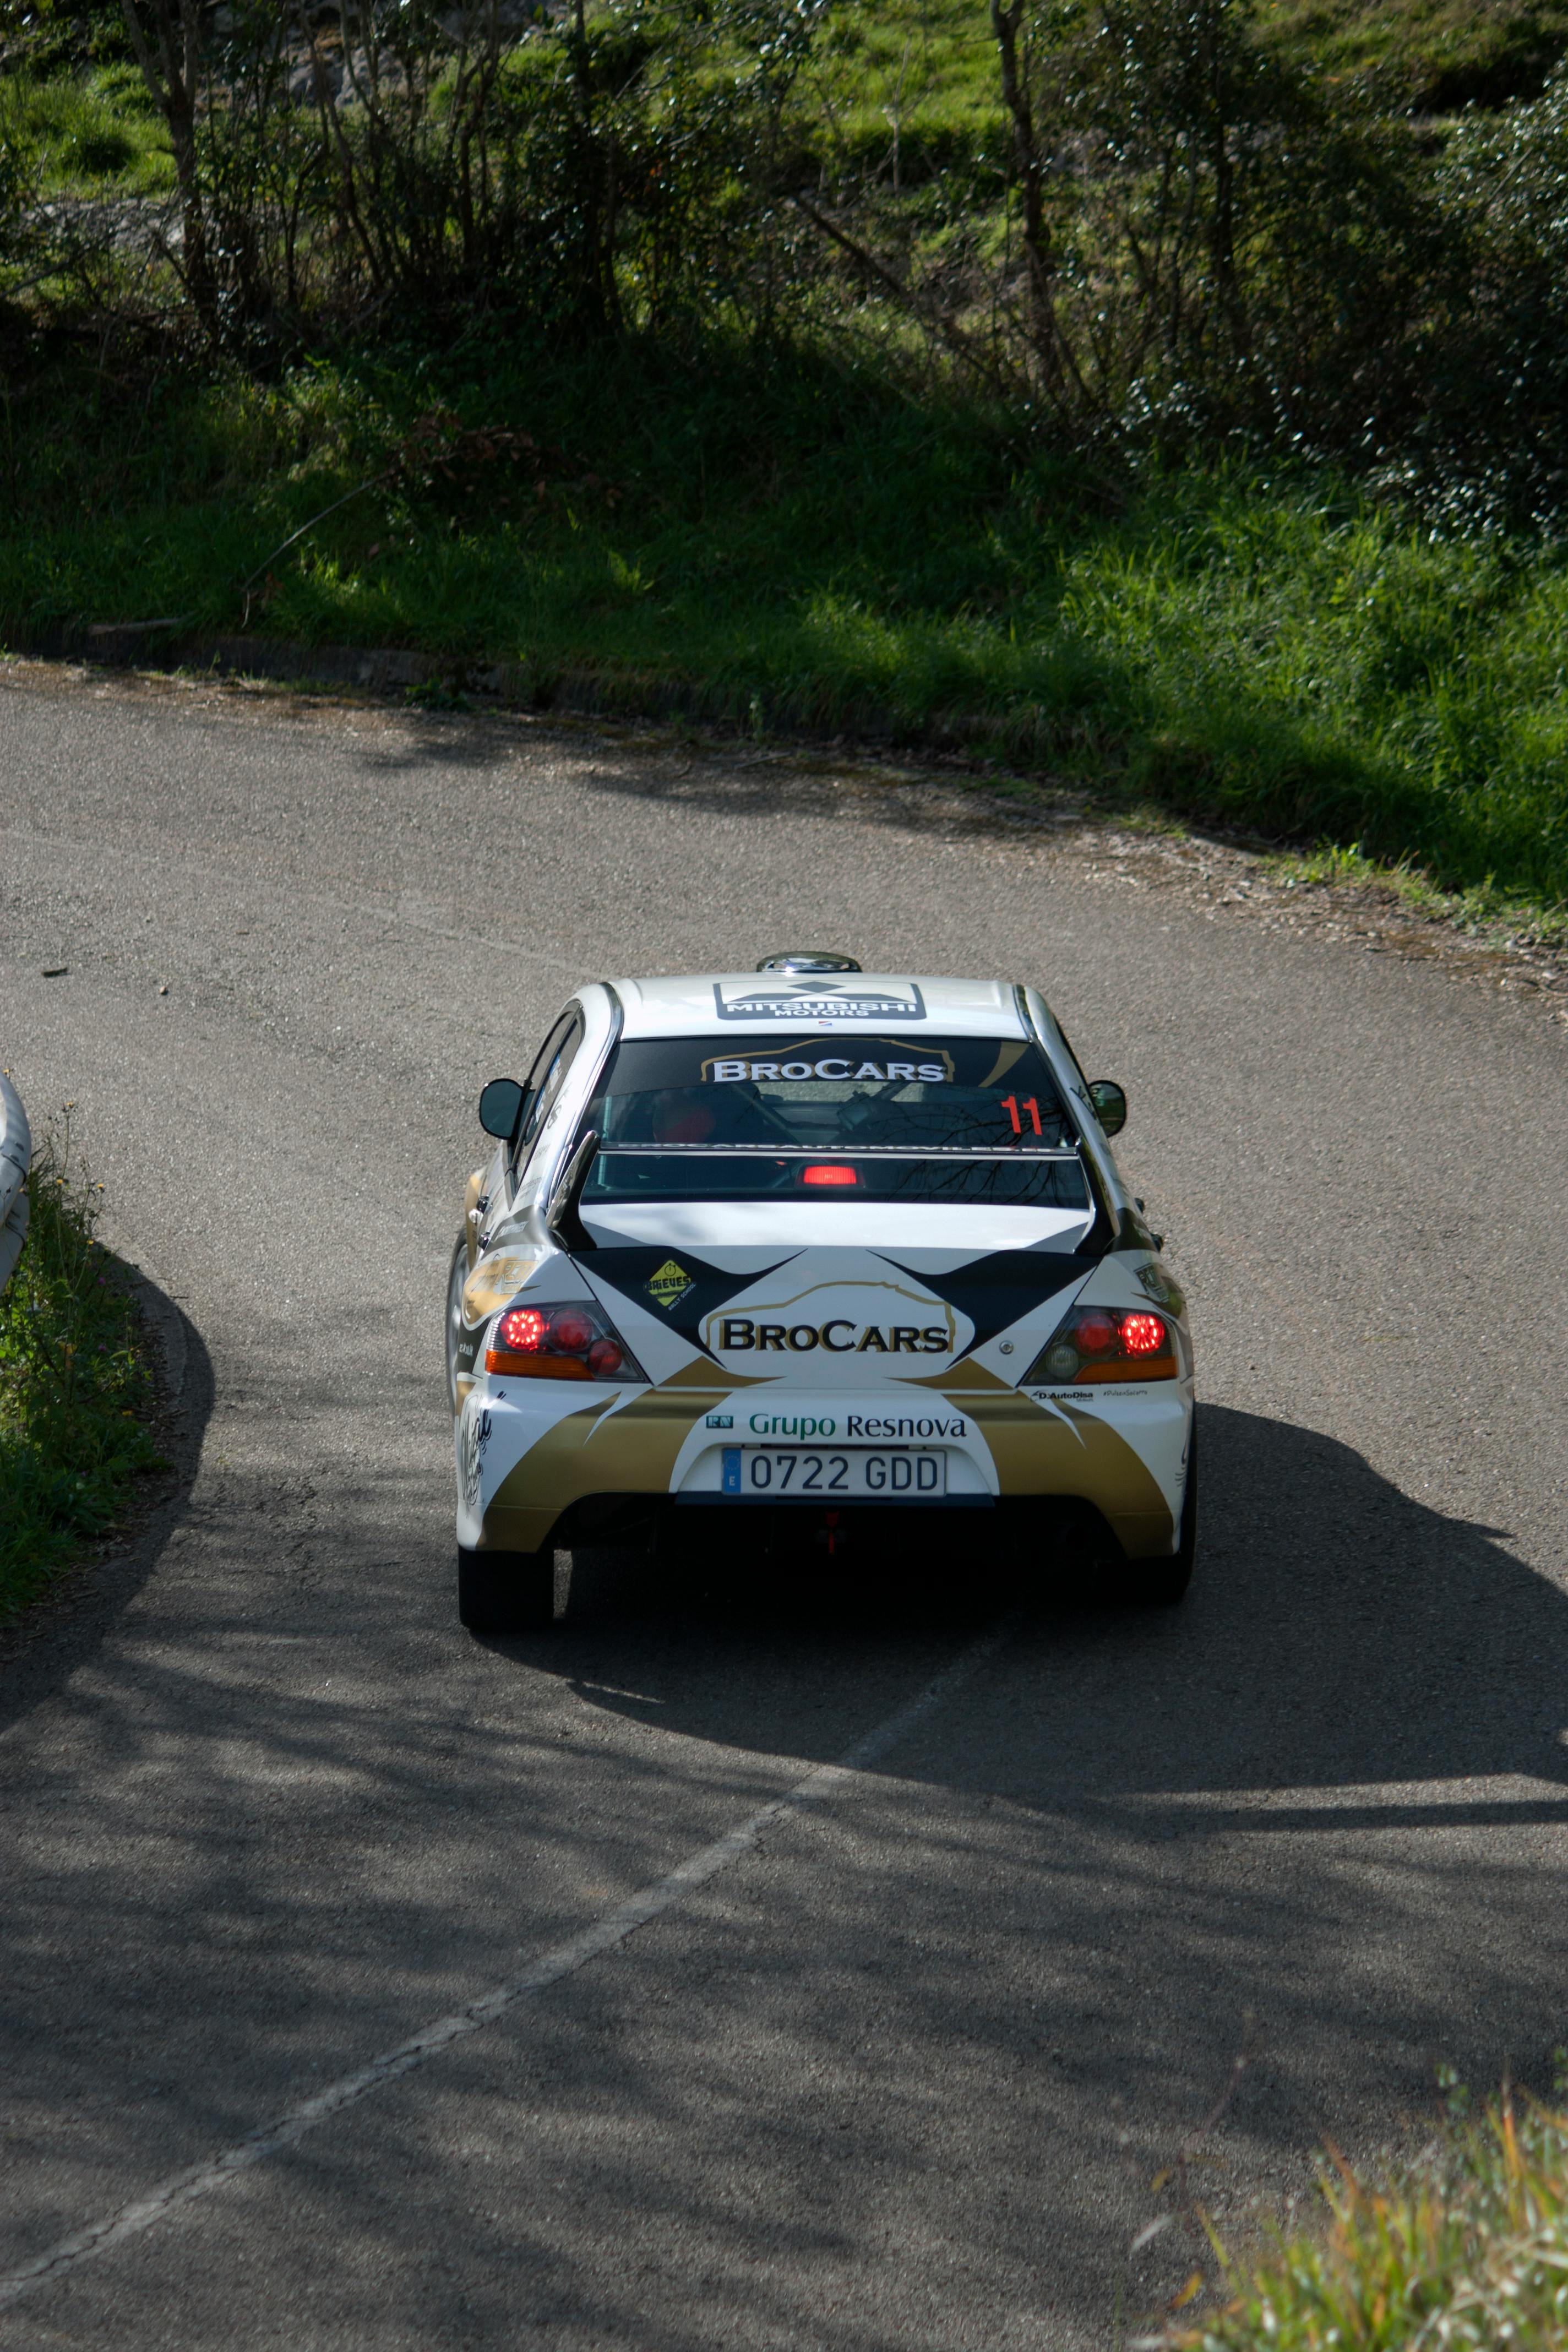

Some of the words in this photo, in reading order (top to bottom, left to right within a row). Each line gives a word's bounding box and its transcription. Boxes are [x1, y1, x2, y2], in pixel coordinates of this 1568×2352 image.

[727, 1003, 917, 1012] MITSUBISHI
[1001, 1095, 1042, 1135] 11
[749, 1413, 836, 1440] Grupo
[847, 1414, 967, 1438] Resnova
[729, 1476, 736, 1487] E
[750, 1455, 849, 1490] 0722
[865, 1456, 938, 1490] GDD
